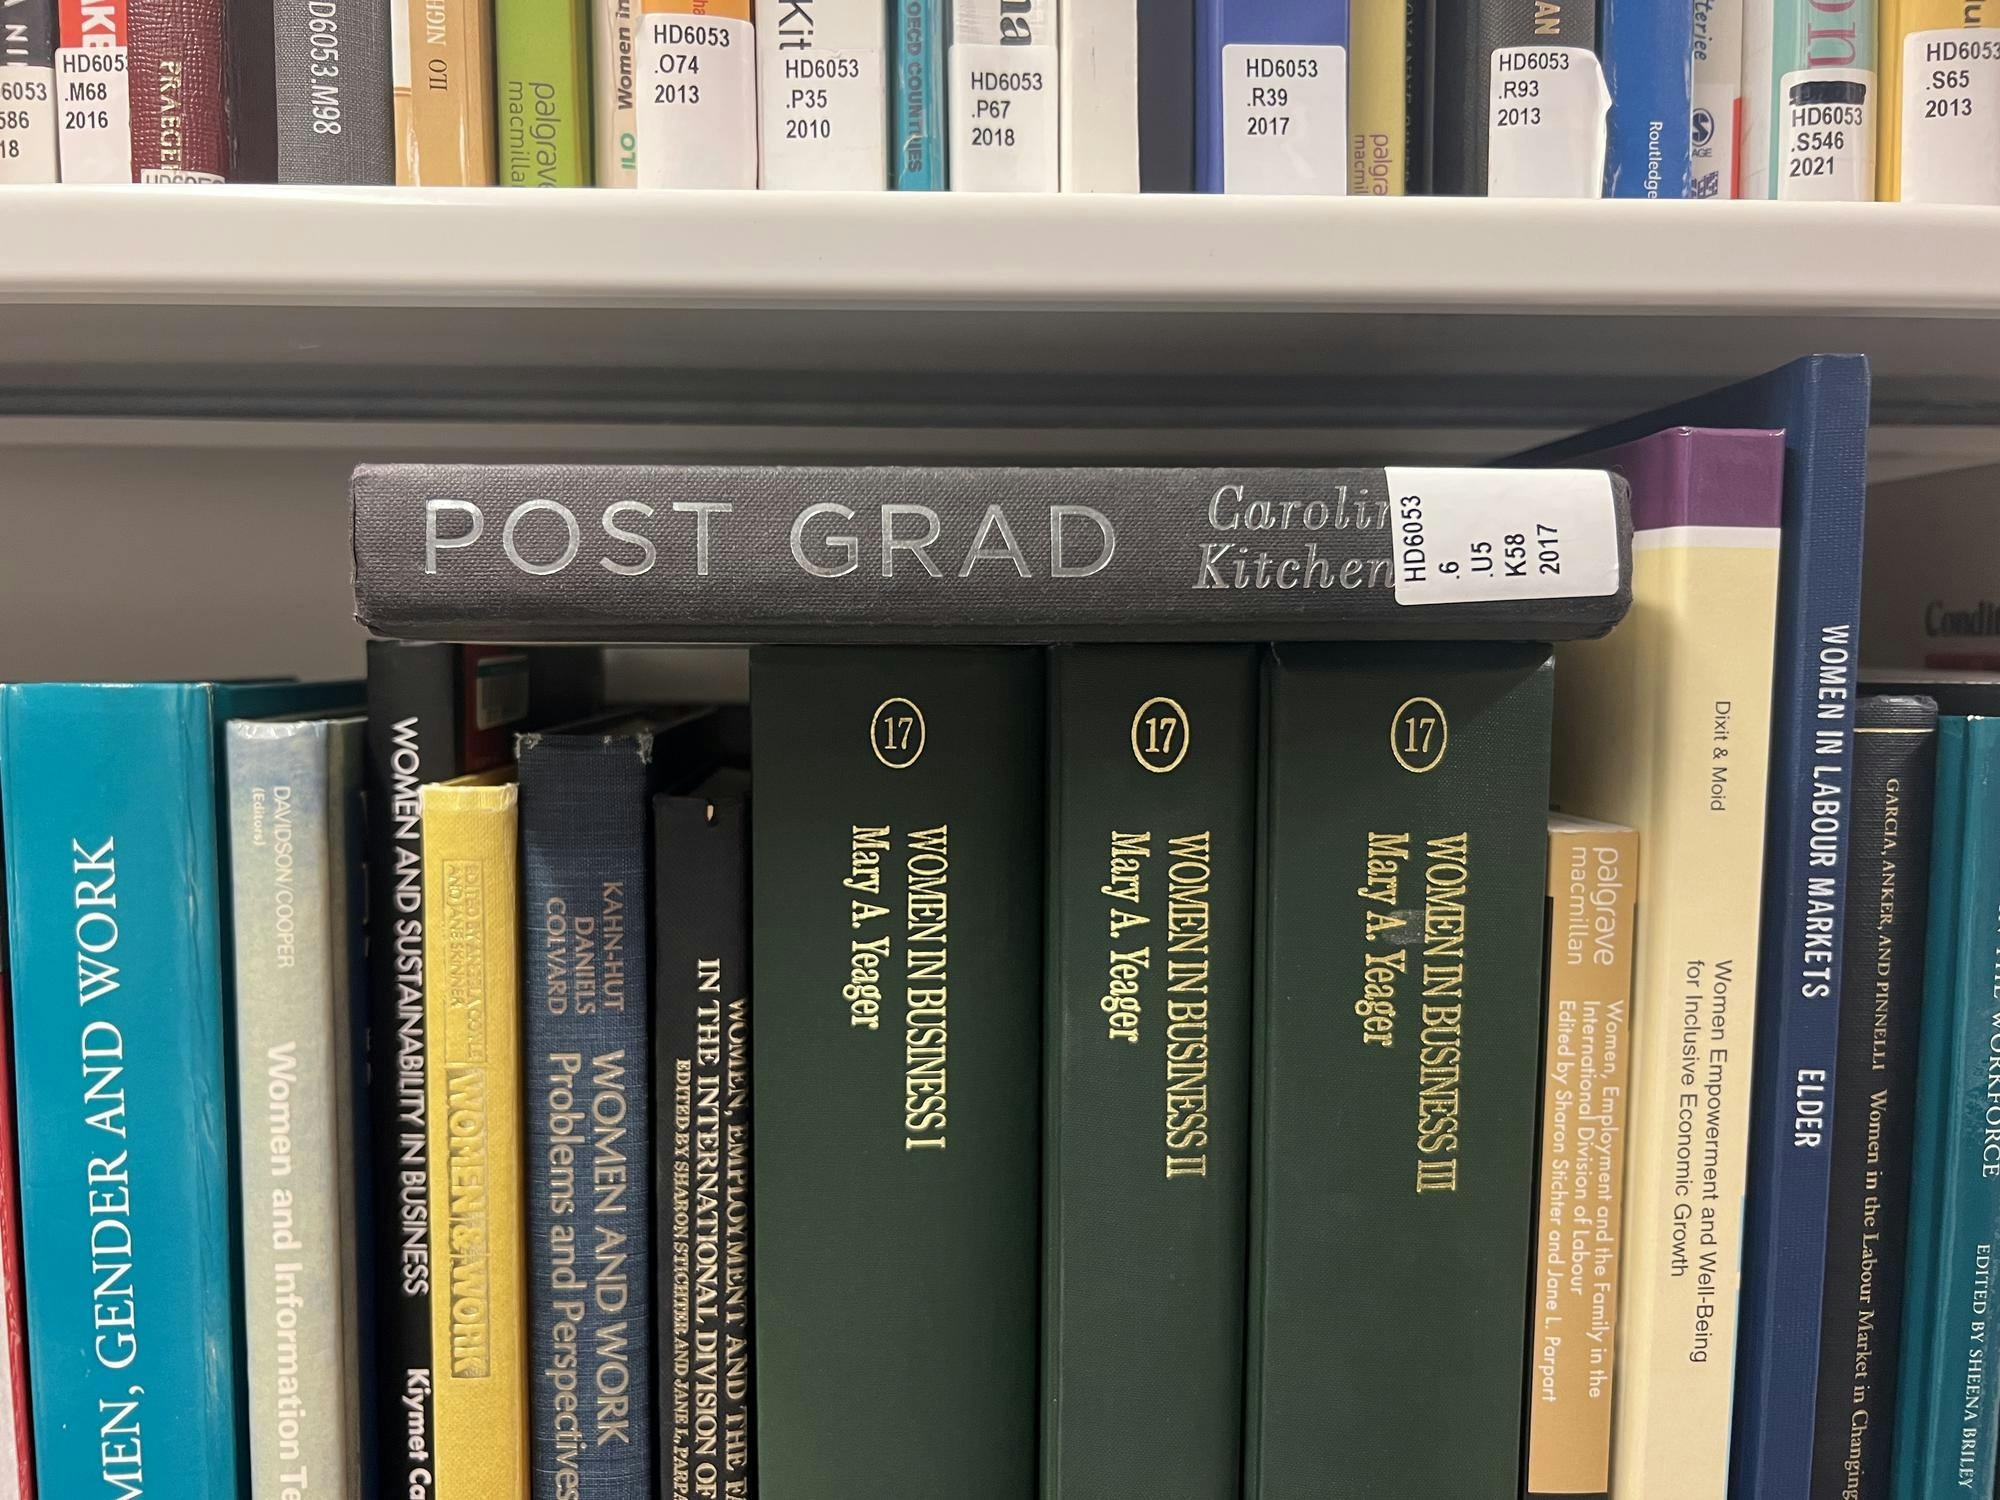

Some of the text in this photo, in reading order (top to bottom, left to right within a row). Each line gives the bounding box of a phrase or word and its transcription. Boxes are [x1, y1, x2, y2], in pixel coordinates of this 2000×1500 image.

[429, 59, 448, 91] ILO
[618, 26, 633, 110] Women
[654, 25, 730, 47] HD6053
[785, 59, 859, 79] HD6053
[1246, 58, 1318, 79] HD6053
[1500, 53, 1569, 71] HD6053
[1926, 41, 2000, 62] HD6053
[65, 83, 107, 101] .M68
[654, 85, 700, 103] 2013
[786, 90, 827, 108] .P35
[971, 72, 1043, 91] HD6053
[971, 101, 1010, 118] .P67
[1246, 87, 1288, 107] .R39
[1497, 107, 1541, 126] 2013
[1498, 80, 1539, 99] .R93
[1791, 107, 1862, 127] HD6053
[1925, 98, 1972, 118] 2013
[1926, 70, 1970, 90] .S65
[65, 111, 108, 129] 2016
[620, 133, 636, 170] ILO
[786, 120, 831, 138] 2010
[971, 128, 1015, 146] 2018
[1247, 117, 1290, 136] 2017
[1790, 131, 1844, 152] .S546
[1644, 121, 1663, 199] Routledge
[1789, 156, 1834, 177] 2021
[424, 499, 1117, 578] POST GRAD
[1401, 495, 1427, 582] HD6053
[1439, 560, 1460, 580] .6
[1471, 541, 1493, 577] .U5
[1505, 532, 1527, 577] K58
[1537, 523, 1560, 575] 2017
[882, 717, 913, 750] 17
[1144, 717, 1176, 754] 17
[1403, 718, 1435, 753] 17
[1710, 701, 1731, 811] Dixit & Moid
[252, 786, 267, 846] (Editors)
[1801, 624, 1850, 999] WOMEN IN LABOUR MARKETS
[273, 786, 296, 969] DAVIDSON/COOPER
[1567, 847, 1590, 965] macmillan
[1589, 847, 1623, 966] palgrave
[545, 897, 567, 1015] COLVARD
[603, 881, 624, 1012] KAHN-HUT
[842, 825, 891, 1030] Mary A. Yeager
[1099, 830, 1151, 1045] Mary A. Yeager
[1354, 831, 1409, 1049] Mary A. Yeager
[1872, 778, 1901, 1072] GARCIA, ANKER, AND PINNELLI
[575, 917, 595, 1015] DANIELS
[905, 824, 948, 1152] WOMEN IN BUSINESS I
[1166, 830, 1210, 1179] WOMEN IN BUSINESS II
[391, 716, 429, 1297] WOMEN AND SUSTAINABILITY IN BUSINESS
[1415, 832, 1468, 1194] WOMEN IN BUSINESS III
[72, 836, 138, 1369] GENDER AND WORK
[1671, 959, 1705, 1277] for Inclusive Economic Growth
[1794, 1069, 1826, 1148] ELDER
[1570, 1001, 1600, 1296] International Division of Labour
[1689, 960, 1733, 1363] Women Empowerment and Well-Being
[448, 1071, 487, 1374] WOMEN & WORK
[695, 958, 720, 1500] IN THE INTERNATIONAL DIVISION OF
[724, 998, 748, 1471] WOMEN, EMPLOYMENT AND THE
[1539, 1001, 1577, 1403] Edited by Sharon Stichter and Jane L. Parpart
[1585, 1000, 1624, 1399] Women, Employment and the Family in the
[268, 1041, 307, 1461] Women and Information
[546, 1052, 588, 1500] Problems and Perspectives
[592, 1050, 629, 1445] WOMEN AND WORK
[673, 1058, 691, 1424] EDITED BY SHARON STICHTER AND JANE
[1842, 1089, 1888, 1500] Women in the Labour Market in Changing
[1958, 1244, 1991, 1490] EDITED BY SHEENA BRILEY
